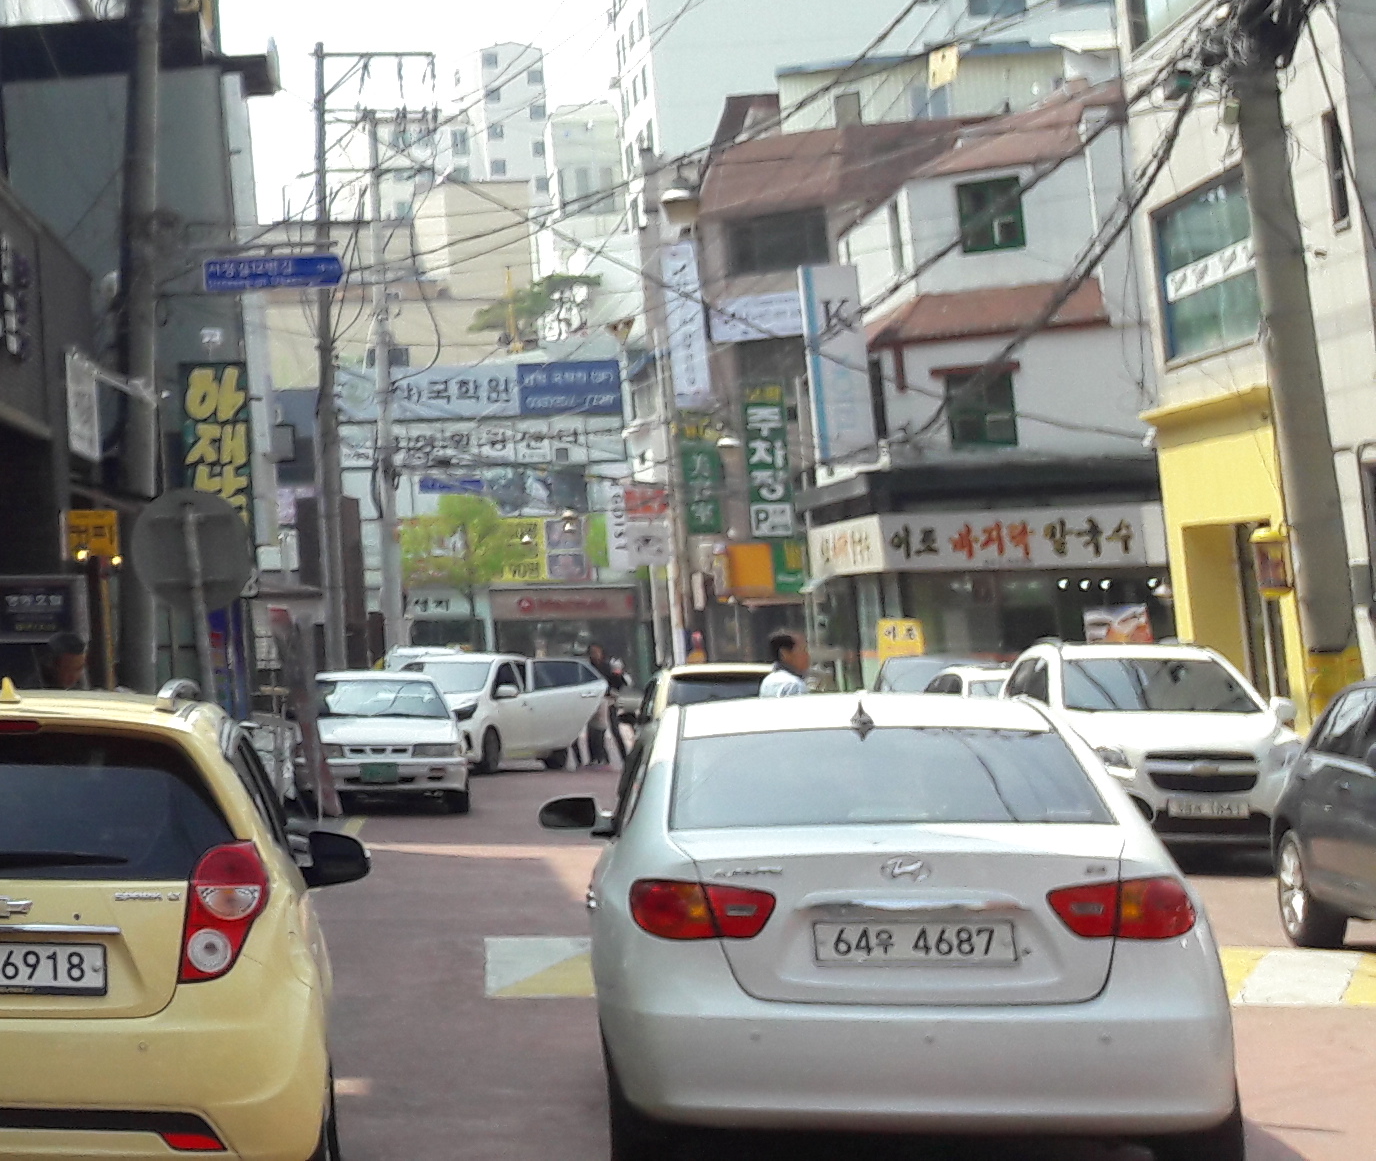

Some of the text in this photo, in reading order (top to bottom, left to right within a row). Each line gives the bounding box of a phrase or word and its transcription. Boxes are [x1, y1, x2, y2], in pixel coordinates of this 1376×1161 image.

[833, 925, 995, 956] 64우 4687
[1, 949, 85, 982] 6918
